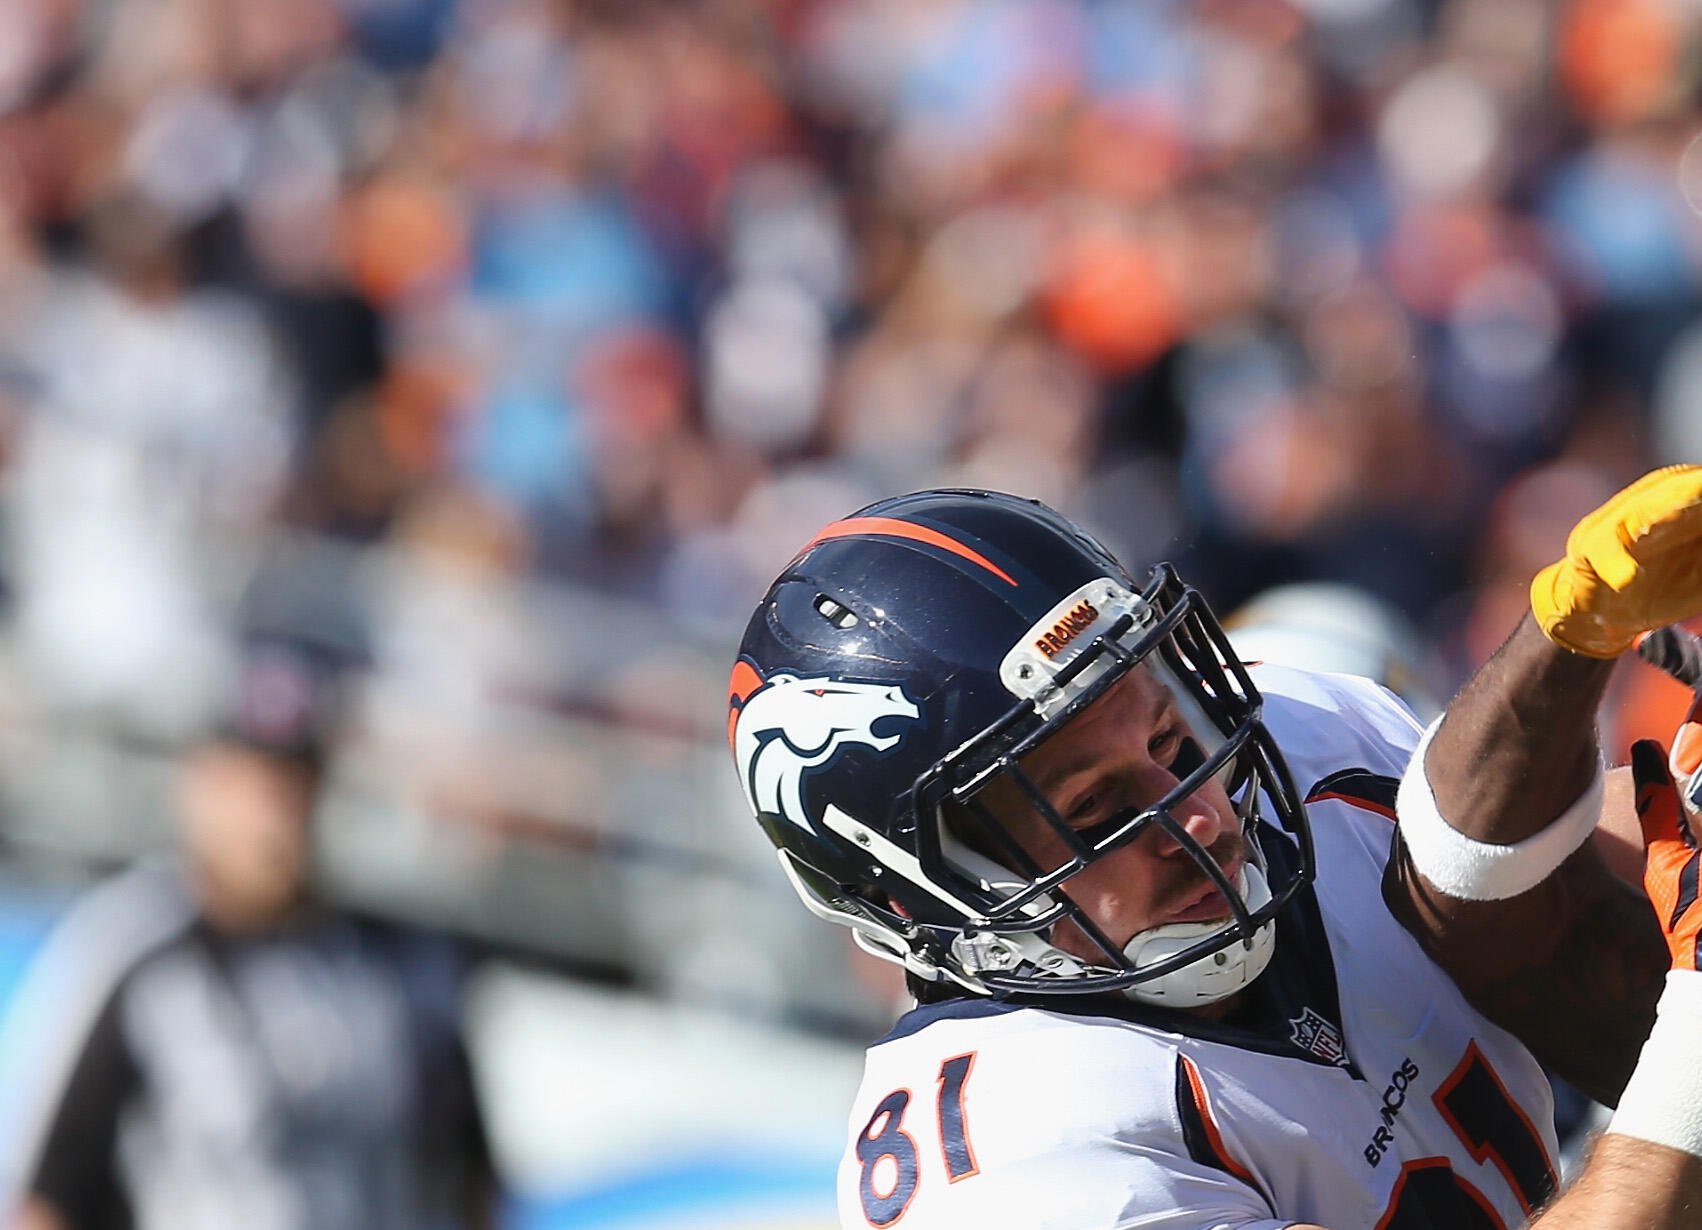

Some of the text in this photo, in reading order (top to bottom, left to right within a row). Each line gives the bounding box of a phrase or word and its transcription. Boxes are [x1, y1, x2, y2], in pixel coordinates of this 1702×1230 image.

[1312, 1030, 1342, 1060] NFL
[856, 1050, 981, 1230] 81
[1364, 1057, 1419, 1168] BRNCOS
